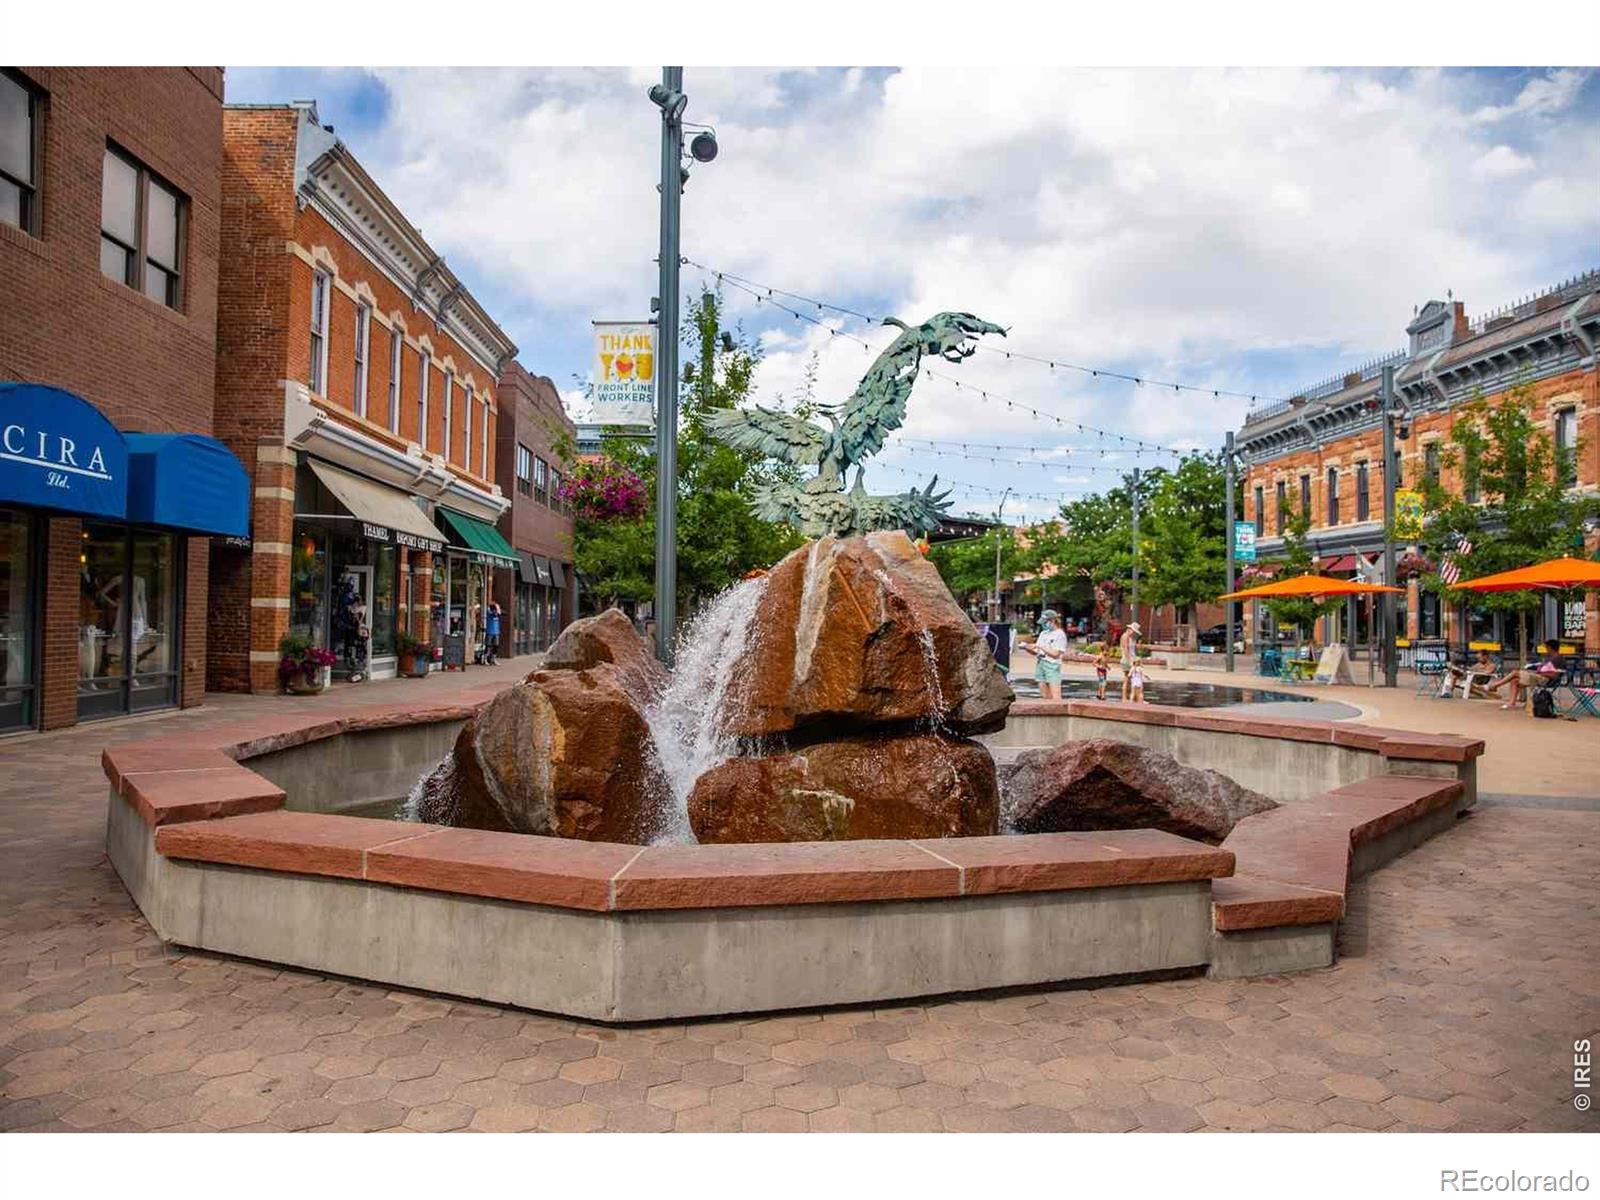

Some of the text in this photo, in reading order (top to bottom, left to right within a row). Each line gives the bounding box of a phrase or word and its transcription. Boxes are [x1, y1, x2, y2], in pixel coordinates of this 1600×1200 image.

[600, 335, 653, 350] THANK
[597, 393, 654, 403] WORKERS
[3, 424, 107, 473] CIRA
